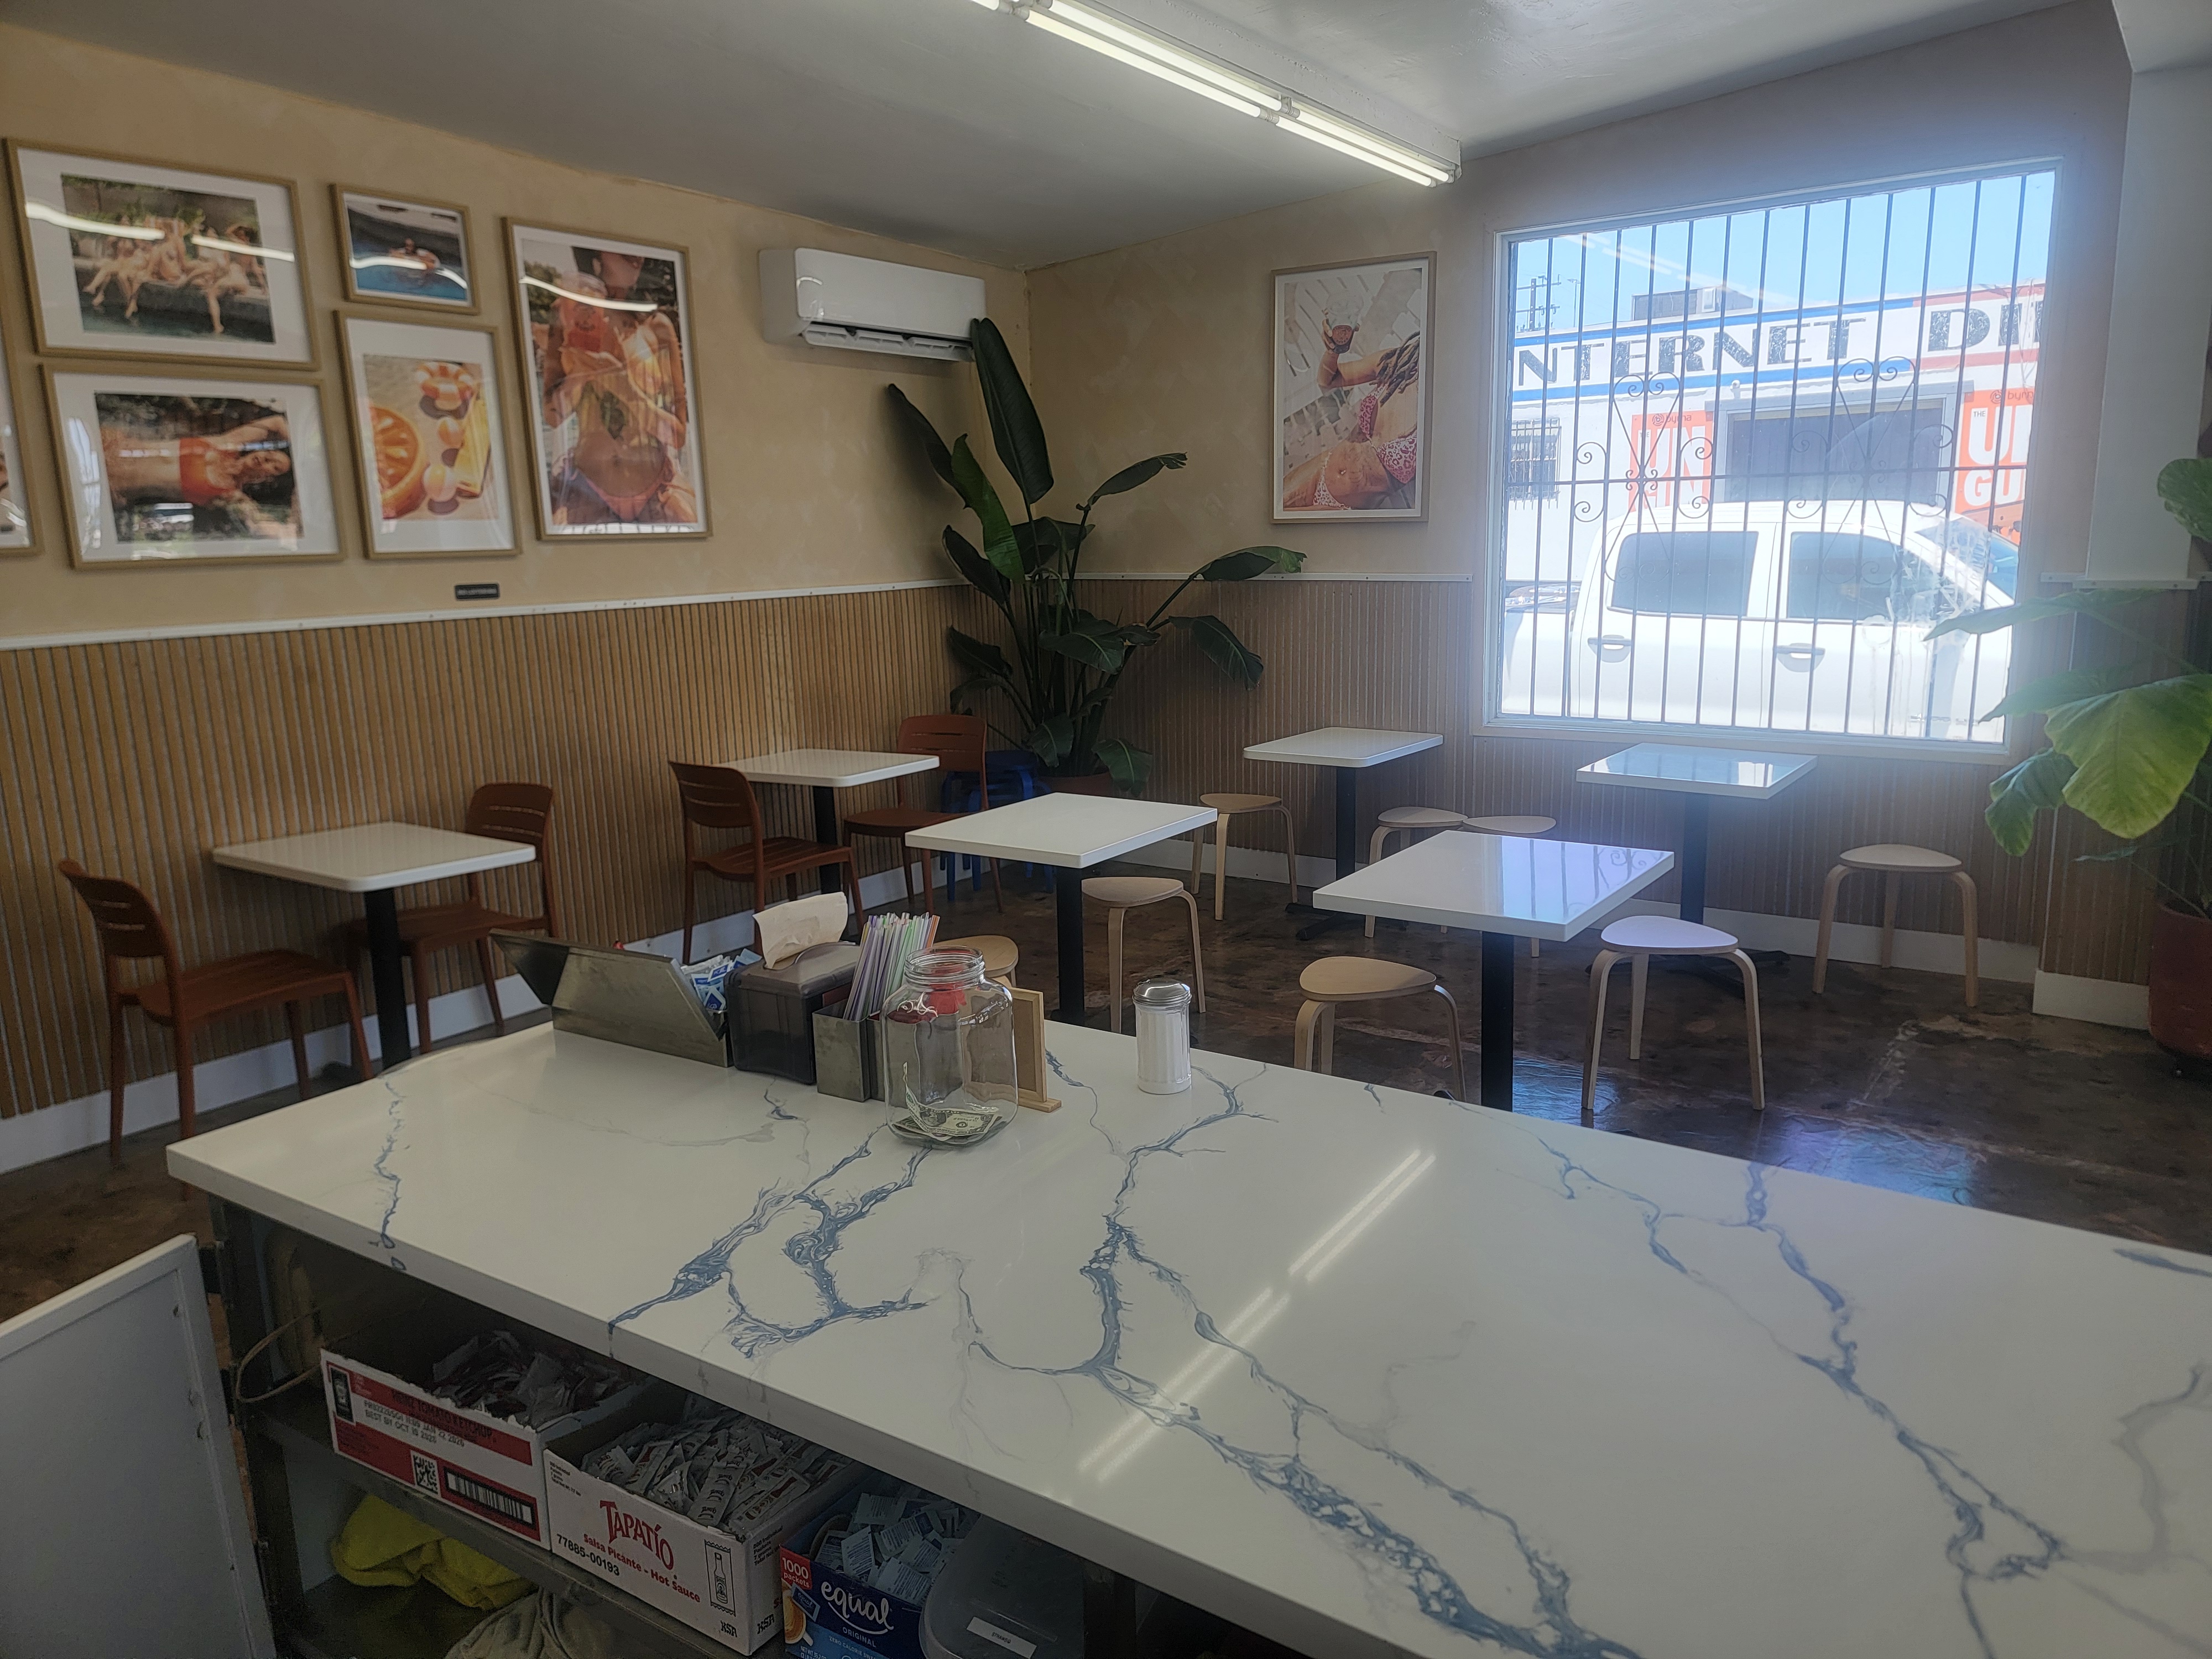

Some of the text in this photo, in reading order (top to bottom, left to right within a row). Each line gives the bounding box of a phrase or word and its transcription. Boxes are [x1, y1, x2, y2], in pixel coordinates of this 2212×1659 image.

[1666, 414, 1692, 424] byna
[1964, 469, 2027, 507] GU
[599, 1500, 675, 1571] TAPATÍO
[556, 1533, 620, 1577] 77885-00193
[583, 1533, 607, 1553] Salsa
[608, 1546, 642, 1572] Picante
[651, 1569, 670, 1587] Hot
[672, 1580, 701, 1603] Sauce
[782, 1557, 810, 1580] 1000
[784, 1572, 810, 1589] packets
[821, 1581, 894, 1631] equal
[720, 1620, 738, 1638] KSA
[842, 1627, 877, 1648] ORIGINAL
[829, 1635, 842, 1646] ZERO
[842, 1642, 863, 1656] CALORIE
